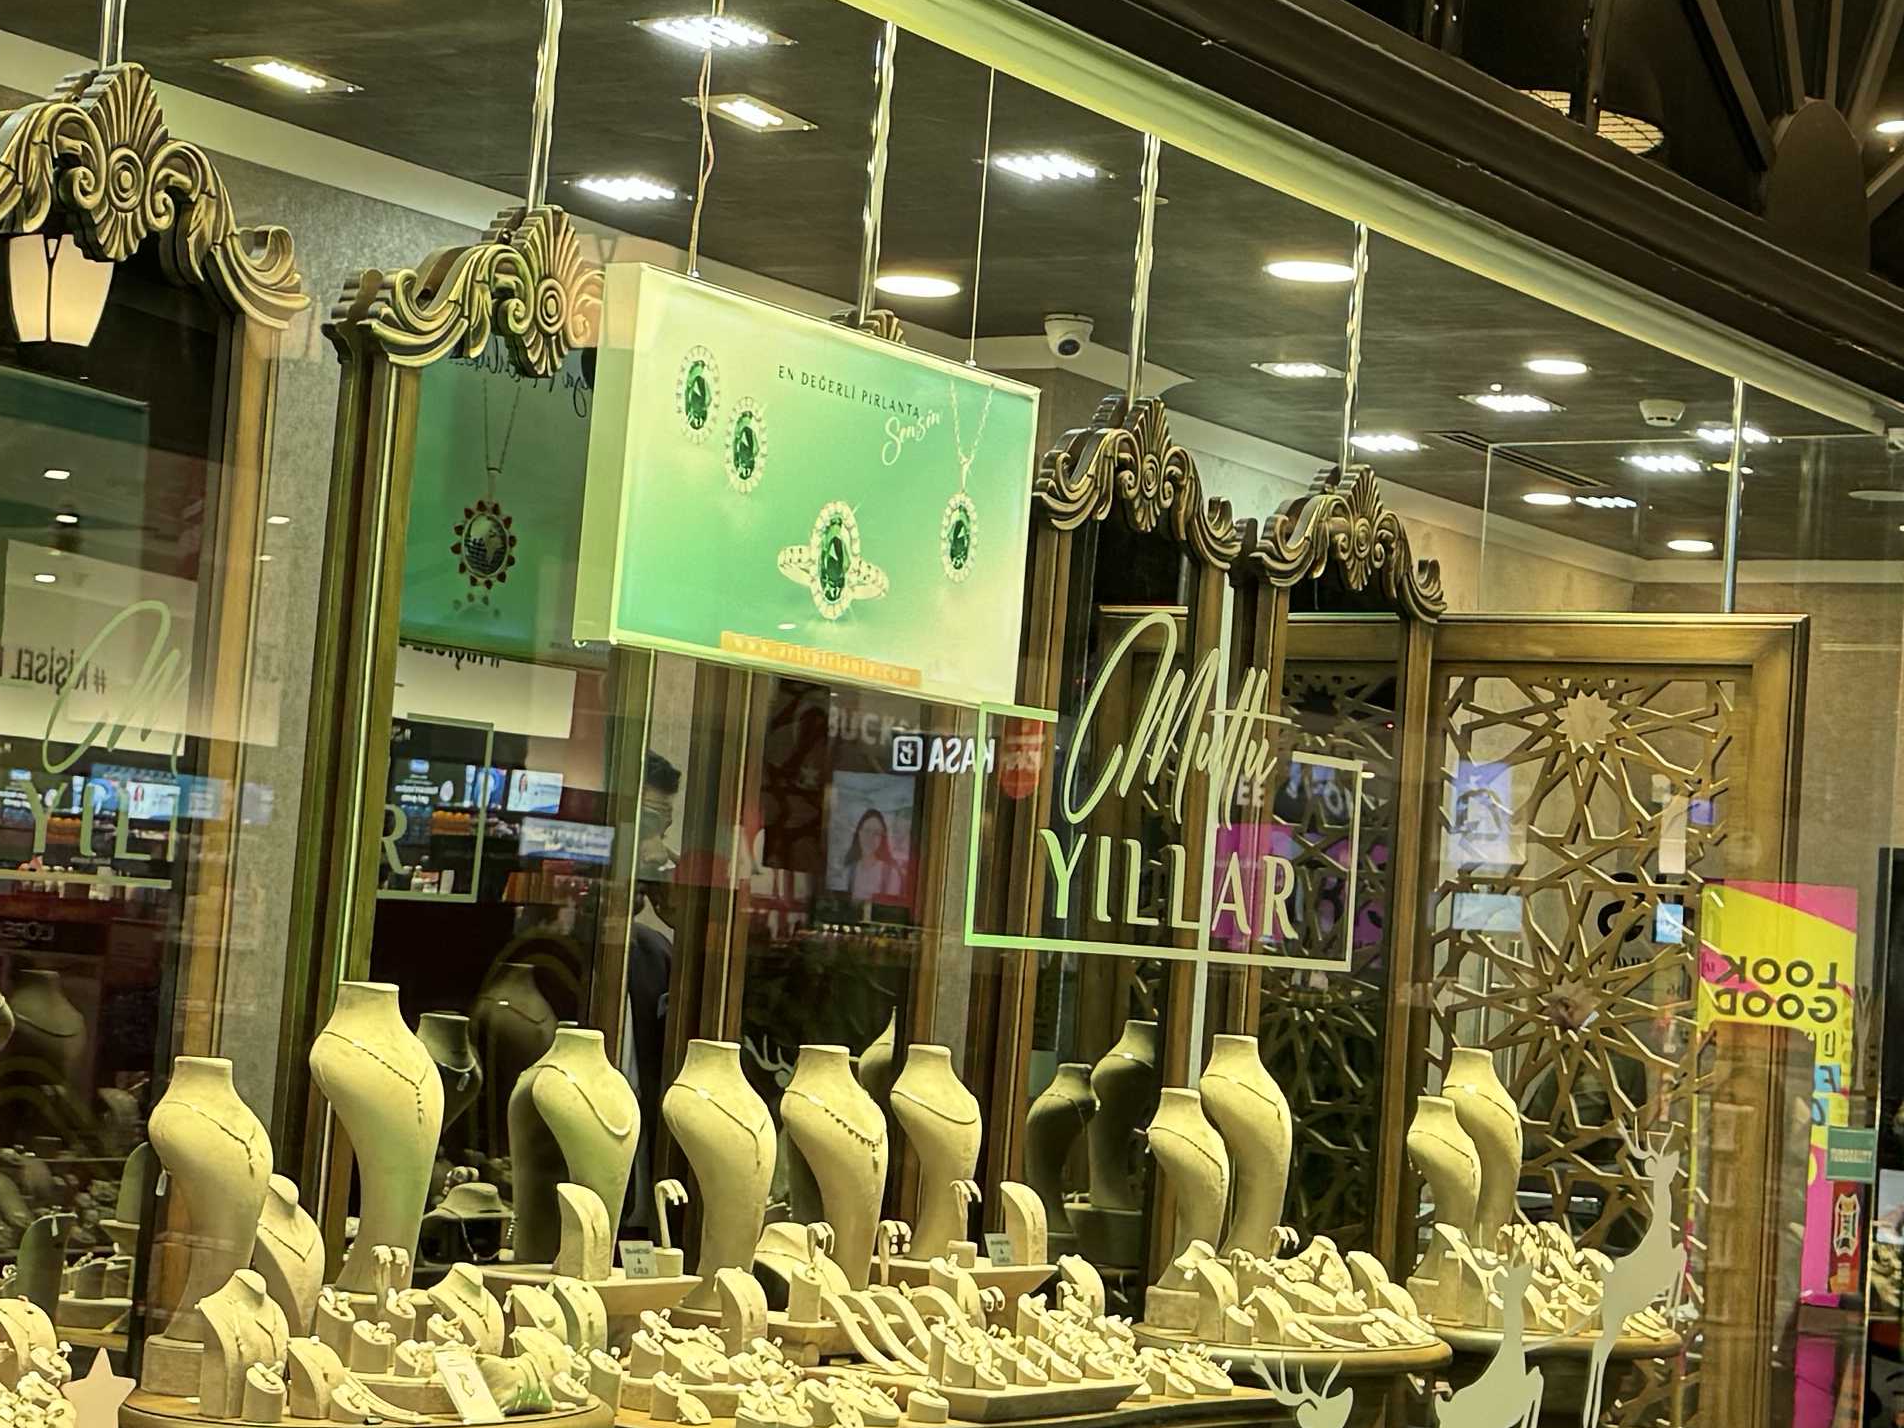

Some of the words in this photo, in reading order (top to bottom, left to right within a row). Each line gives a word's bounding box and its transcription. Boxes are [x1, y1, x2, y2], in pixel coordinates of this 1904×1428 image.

[778, 365, 794, 380] EN
[801, 371, 856, 400] DEĞERLİ
[862, 390, 920, 419] PIRLANTA
[1040, 828, 1299, 940] YILLAR
